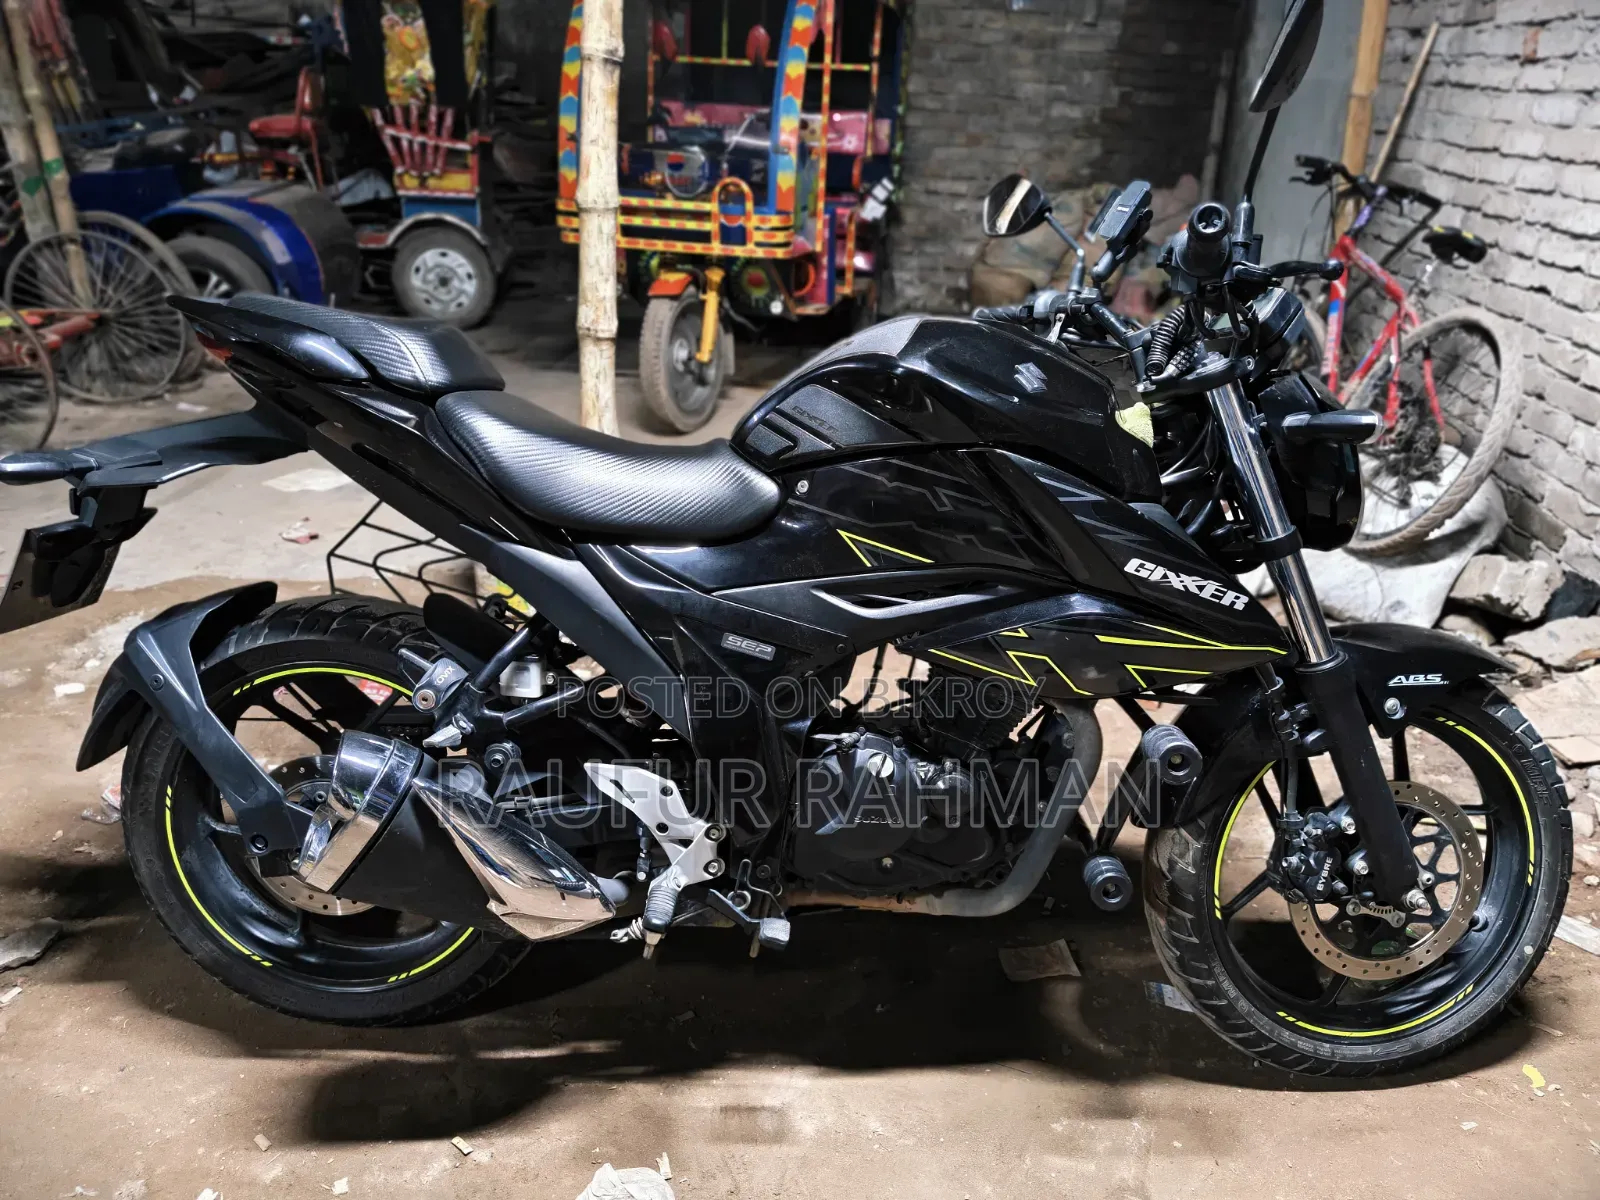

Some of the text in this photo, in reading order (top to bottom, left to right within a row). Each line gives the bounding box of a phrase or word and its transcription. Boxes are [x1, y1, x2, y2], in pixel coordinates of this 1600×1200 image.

[1123, 557, 1250, 611] GIXXER
[726, 635, 772, 652] SEP
[1387, 673, 1443, 687] ABS
[854, 815, 901, 824] SUZUKI
[1316, 856, 1334, 891] BYBRE
